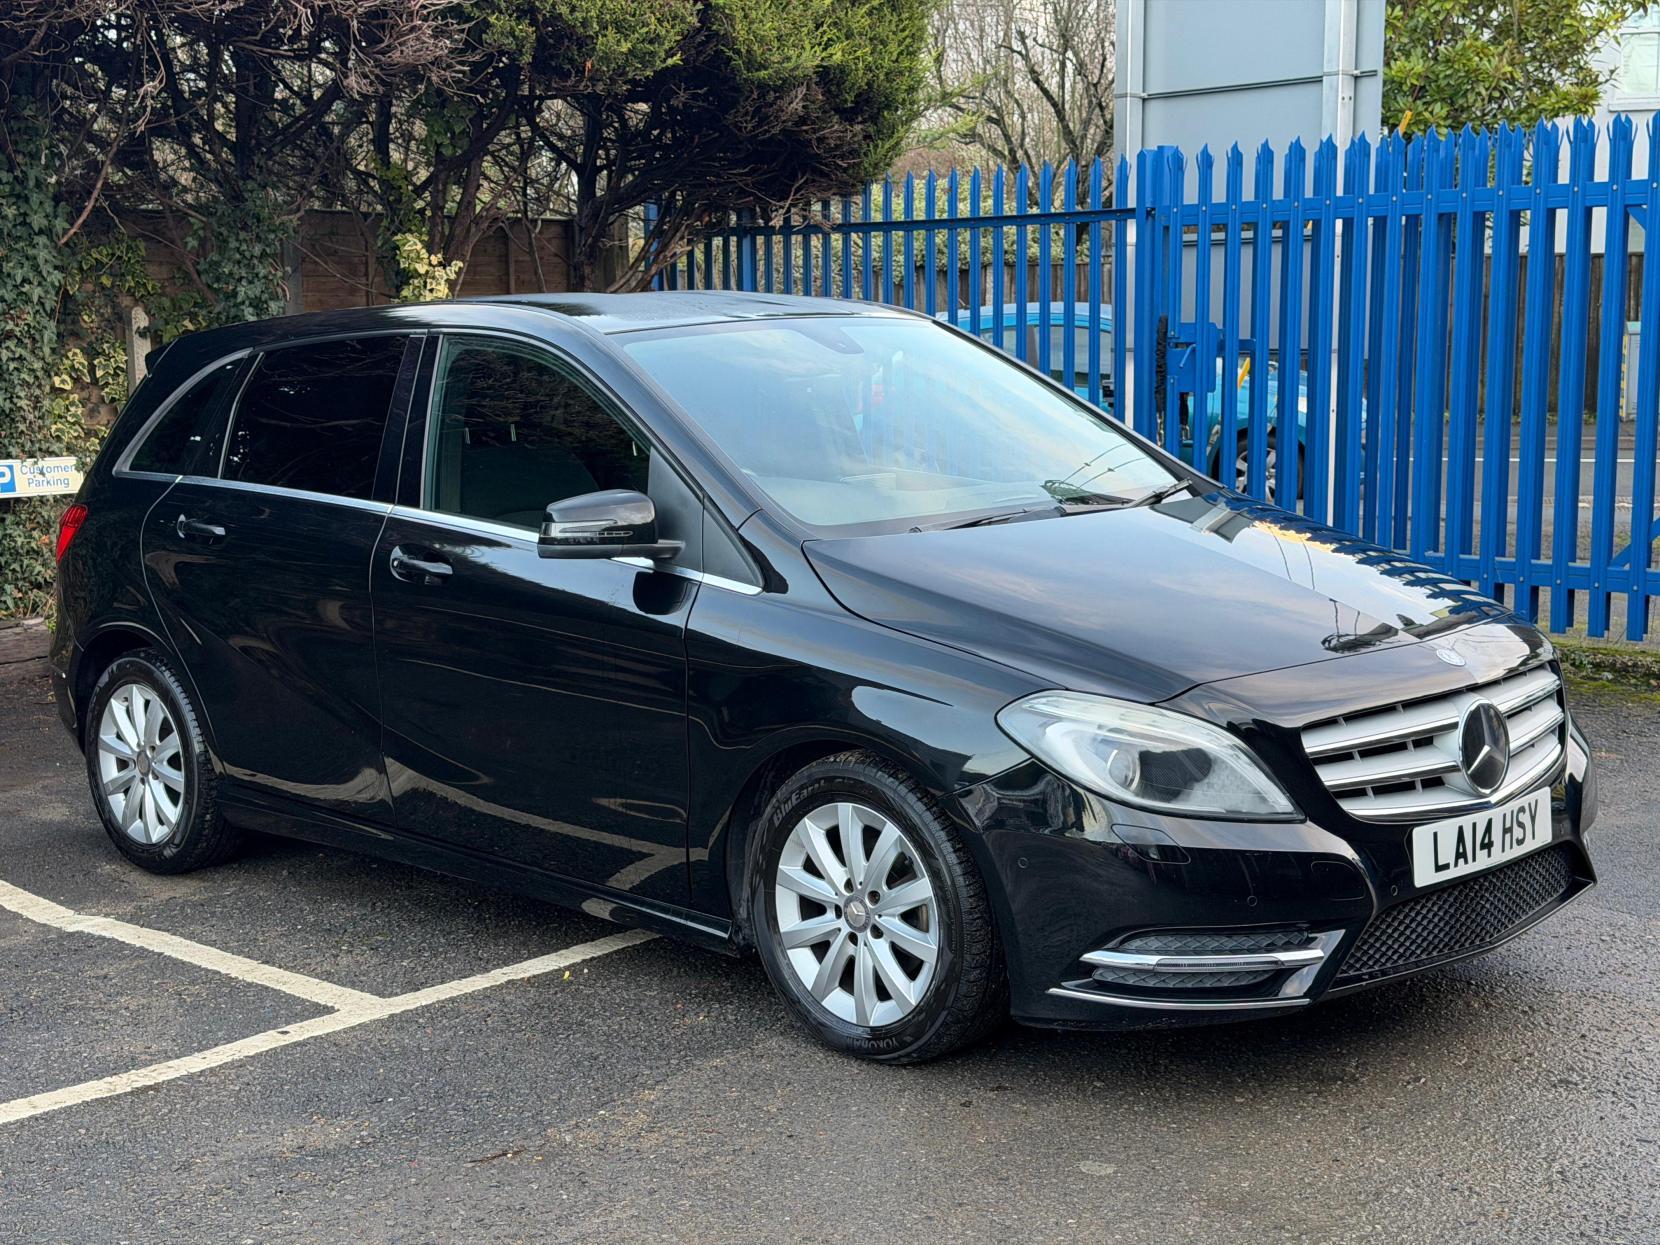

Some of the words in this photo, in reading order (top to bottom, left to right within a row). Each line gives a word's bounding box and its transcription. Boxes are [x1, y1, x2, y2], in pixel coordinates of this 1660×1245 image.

[28, 476, 70, 488] Parking
[1433, 817, 1494, 873] LA14
[1501, 799, 1539, 853] HSY
